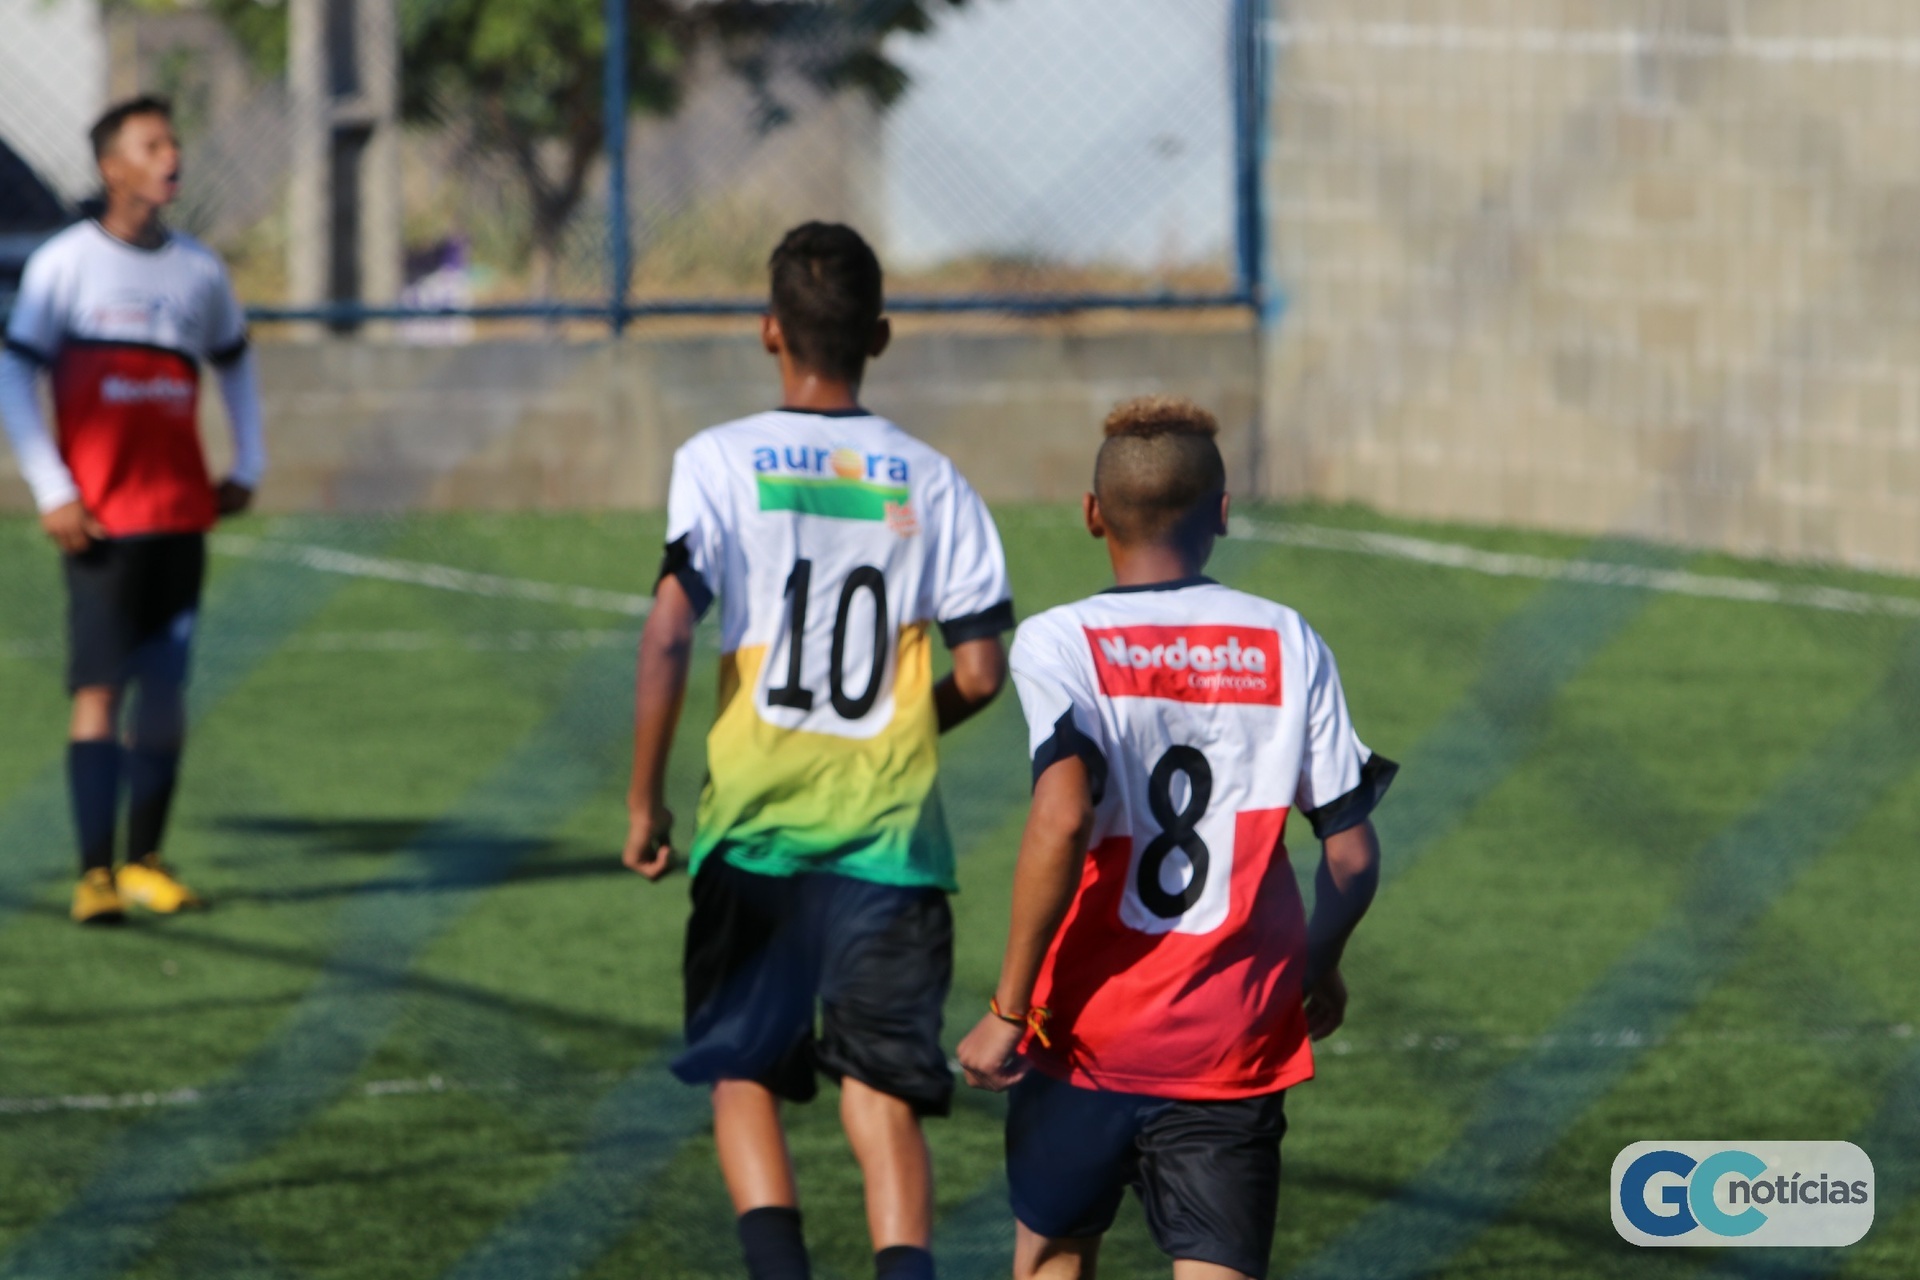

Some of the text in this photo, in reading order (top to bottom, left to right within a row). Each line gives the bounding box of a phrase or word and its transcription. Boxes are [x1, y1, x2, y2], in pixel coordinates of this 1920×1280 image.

[754, 445, 908, 482] aurora
[767, 558, 888, 720] 10
[1137, 745, 1213, 919] 8
